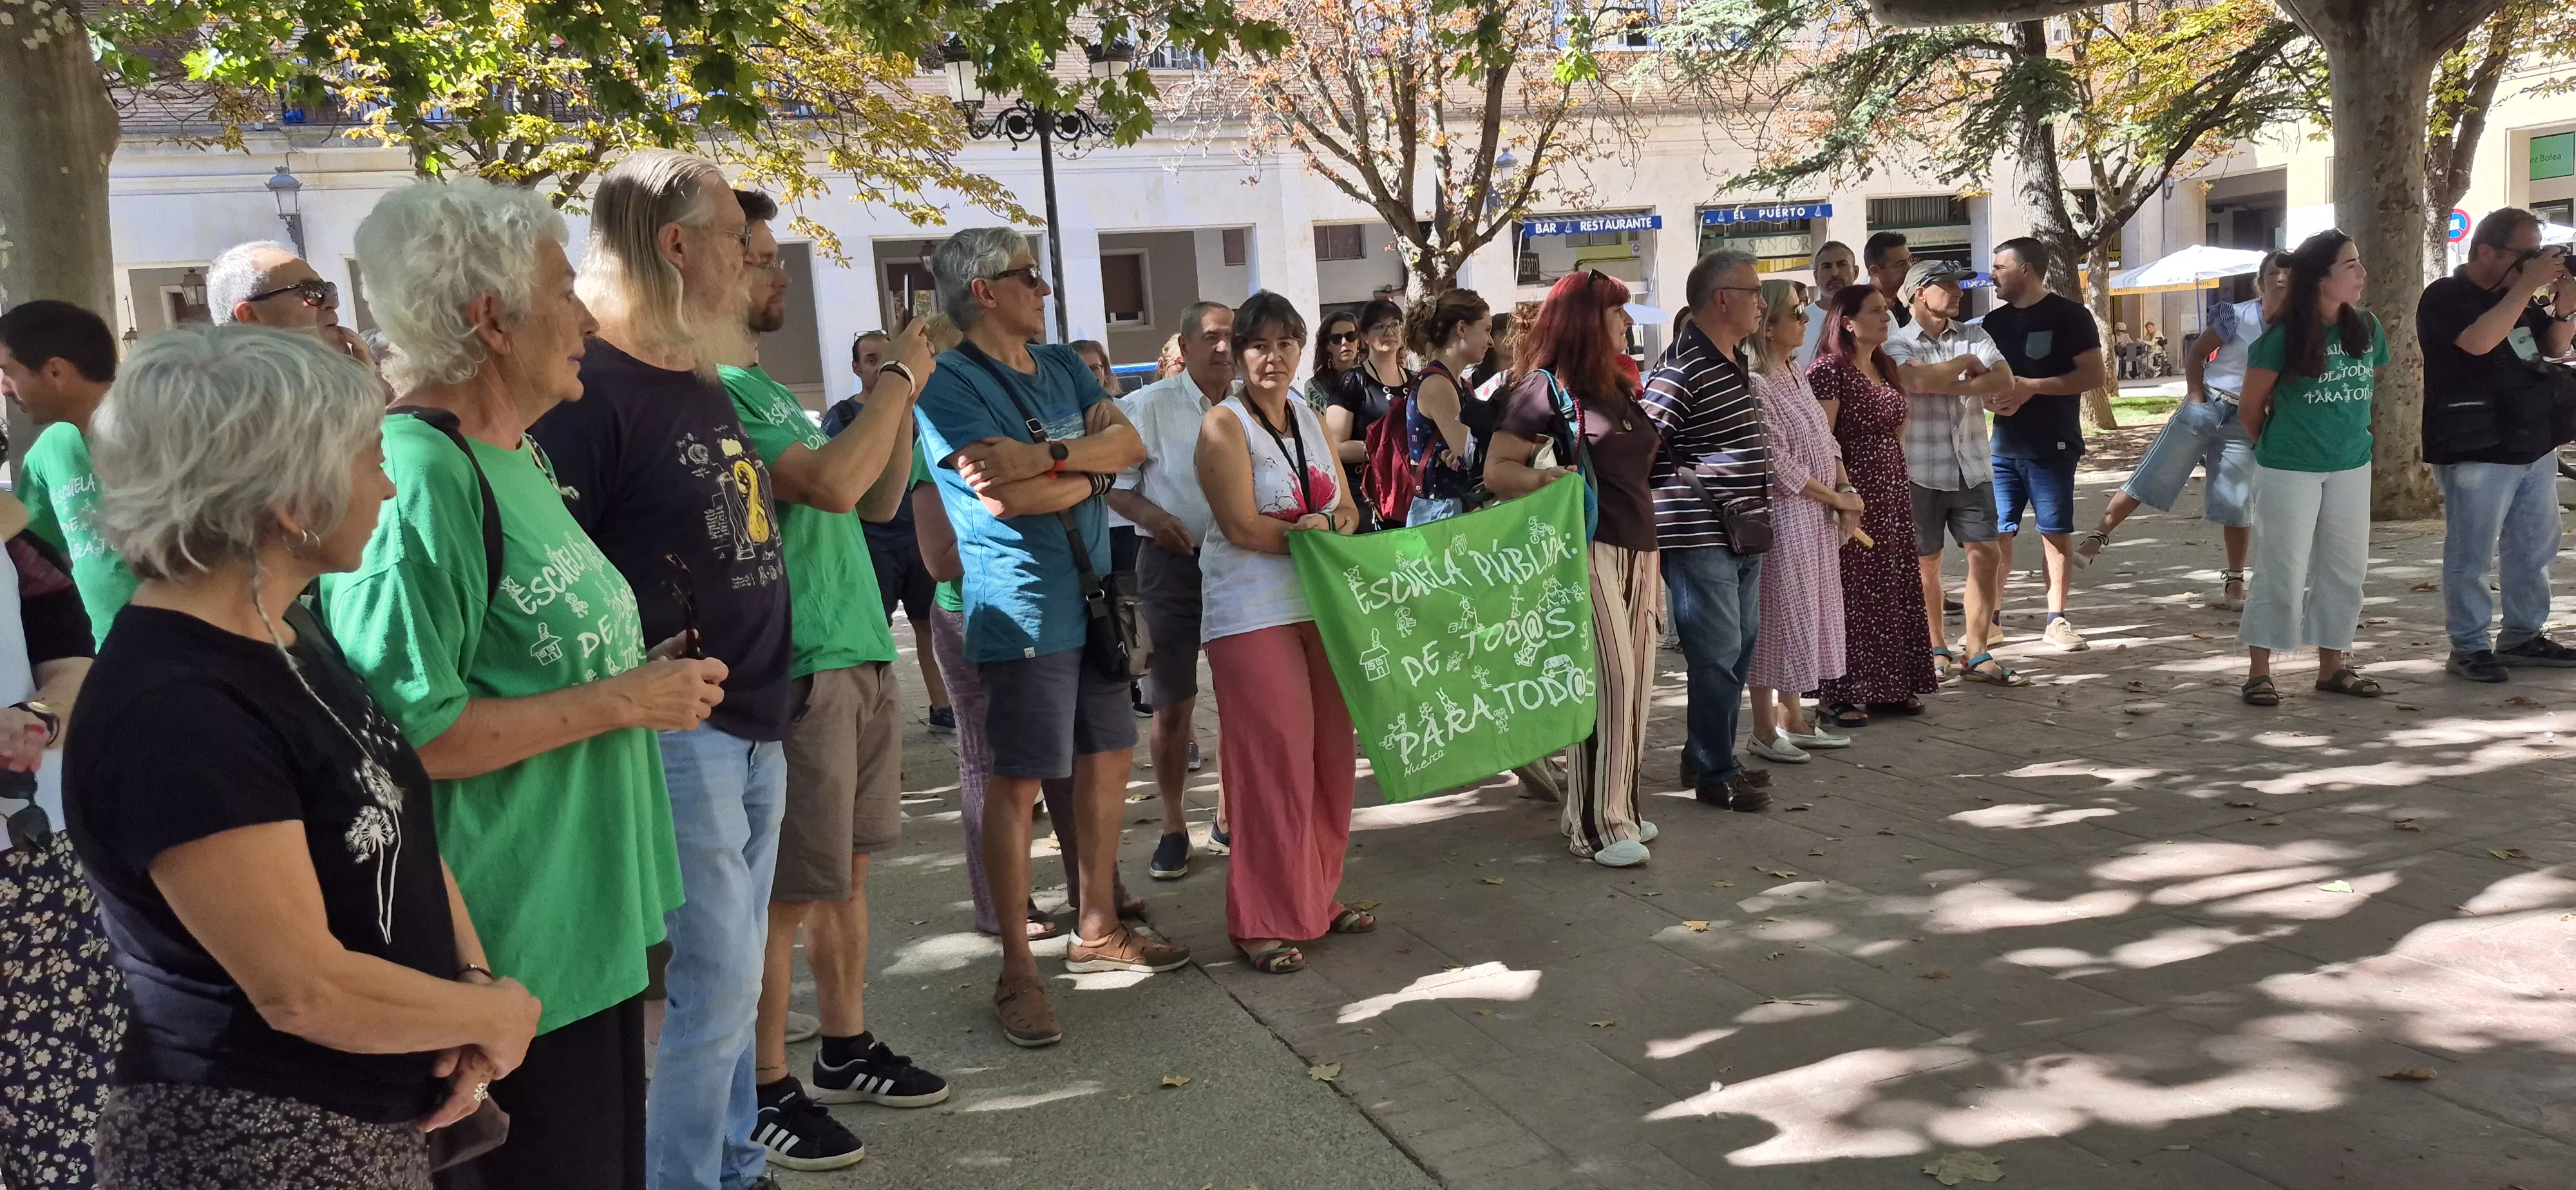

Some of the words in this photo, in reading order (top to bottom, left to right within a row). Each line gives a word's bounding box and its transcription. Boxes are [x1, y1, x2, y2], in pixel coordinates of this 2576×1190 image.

[2540, 153, 2562, 162] Bolea
[1733, 211, 1746, 220] EL
[1759, 207, 1806, 218] PUERTO
[1535, 222, 1557, 234] BAR
[1580, 216, 1652, 232] RESTAURANTE
[1748, 238, 1777, 253] SAN
[1516, 258, 1539, 275] UERTO
[2318, 371, 2337, 383] DE
[1352, 549, 1473, 614] ESCUELA
[1468, 533, 1578, 586] PÚBLICA:
[577, 614, 613, 659] DE
[1401, 640, 1441, 687] DE
[1459, 608, 1576, 659] TOD@S
[1399, 693, 1495, 765] PARA
[1493, 668, 1595, 715] TOD@S
[1404, 750, 1446, 778] Huesca
